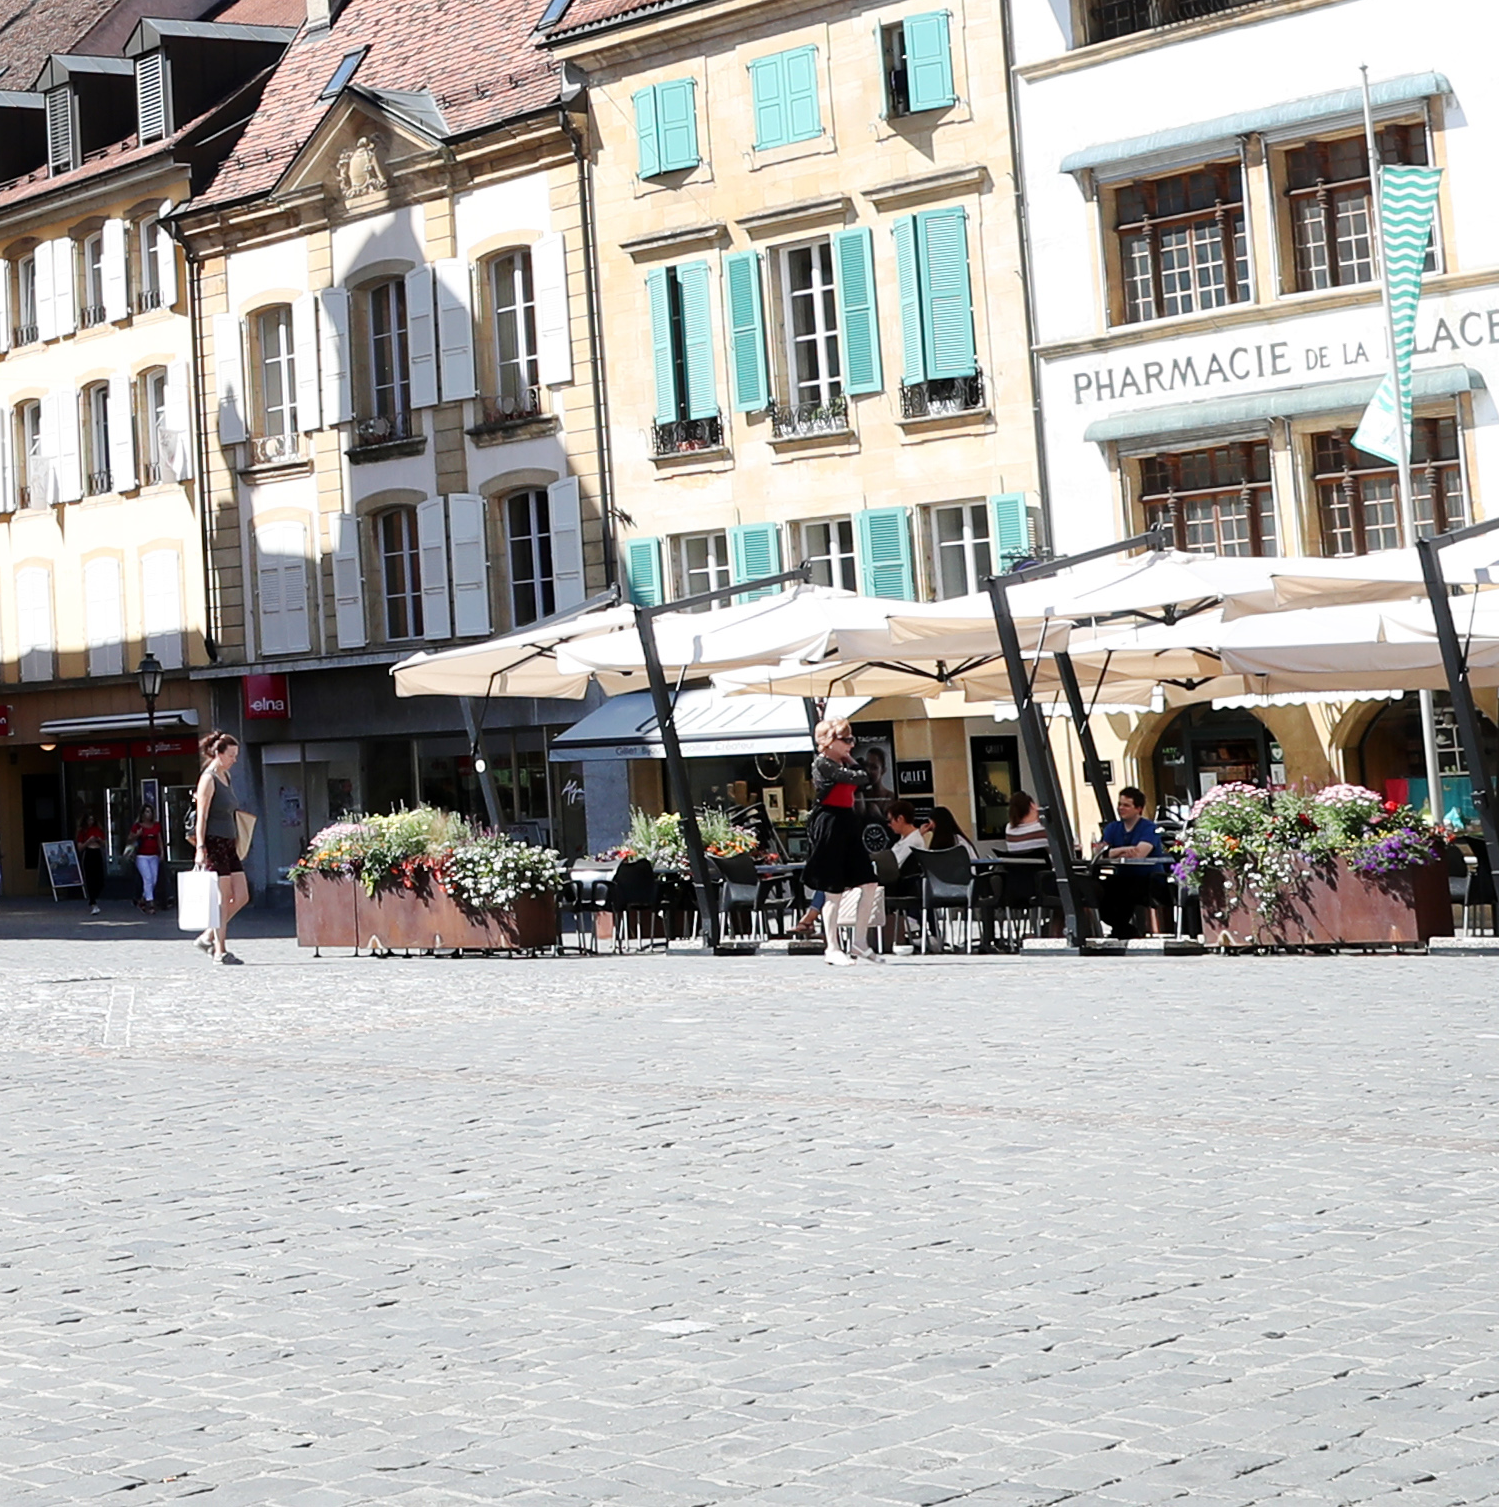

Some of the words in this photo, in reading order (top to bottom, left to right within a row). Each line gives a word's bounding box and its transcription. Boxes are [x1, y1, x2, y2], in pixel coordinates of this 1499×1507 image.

[1073, 341, 1291, 405] PHARMACIE
[1305, 344, 1330, 370] DE
[1343, 341, 1370, 365] LA
[1384, 309, 1499, 359] LACE
[250, 697, 284, 712] elna
